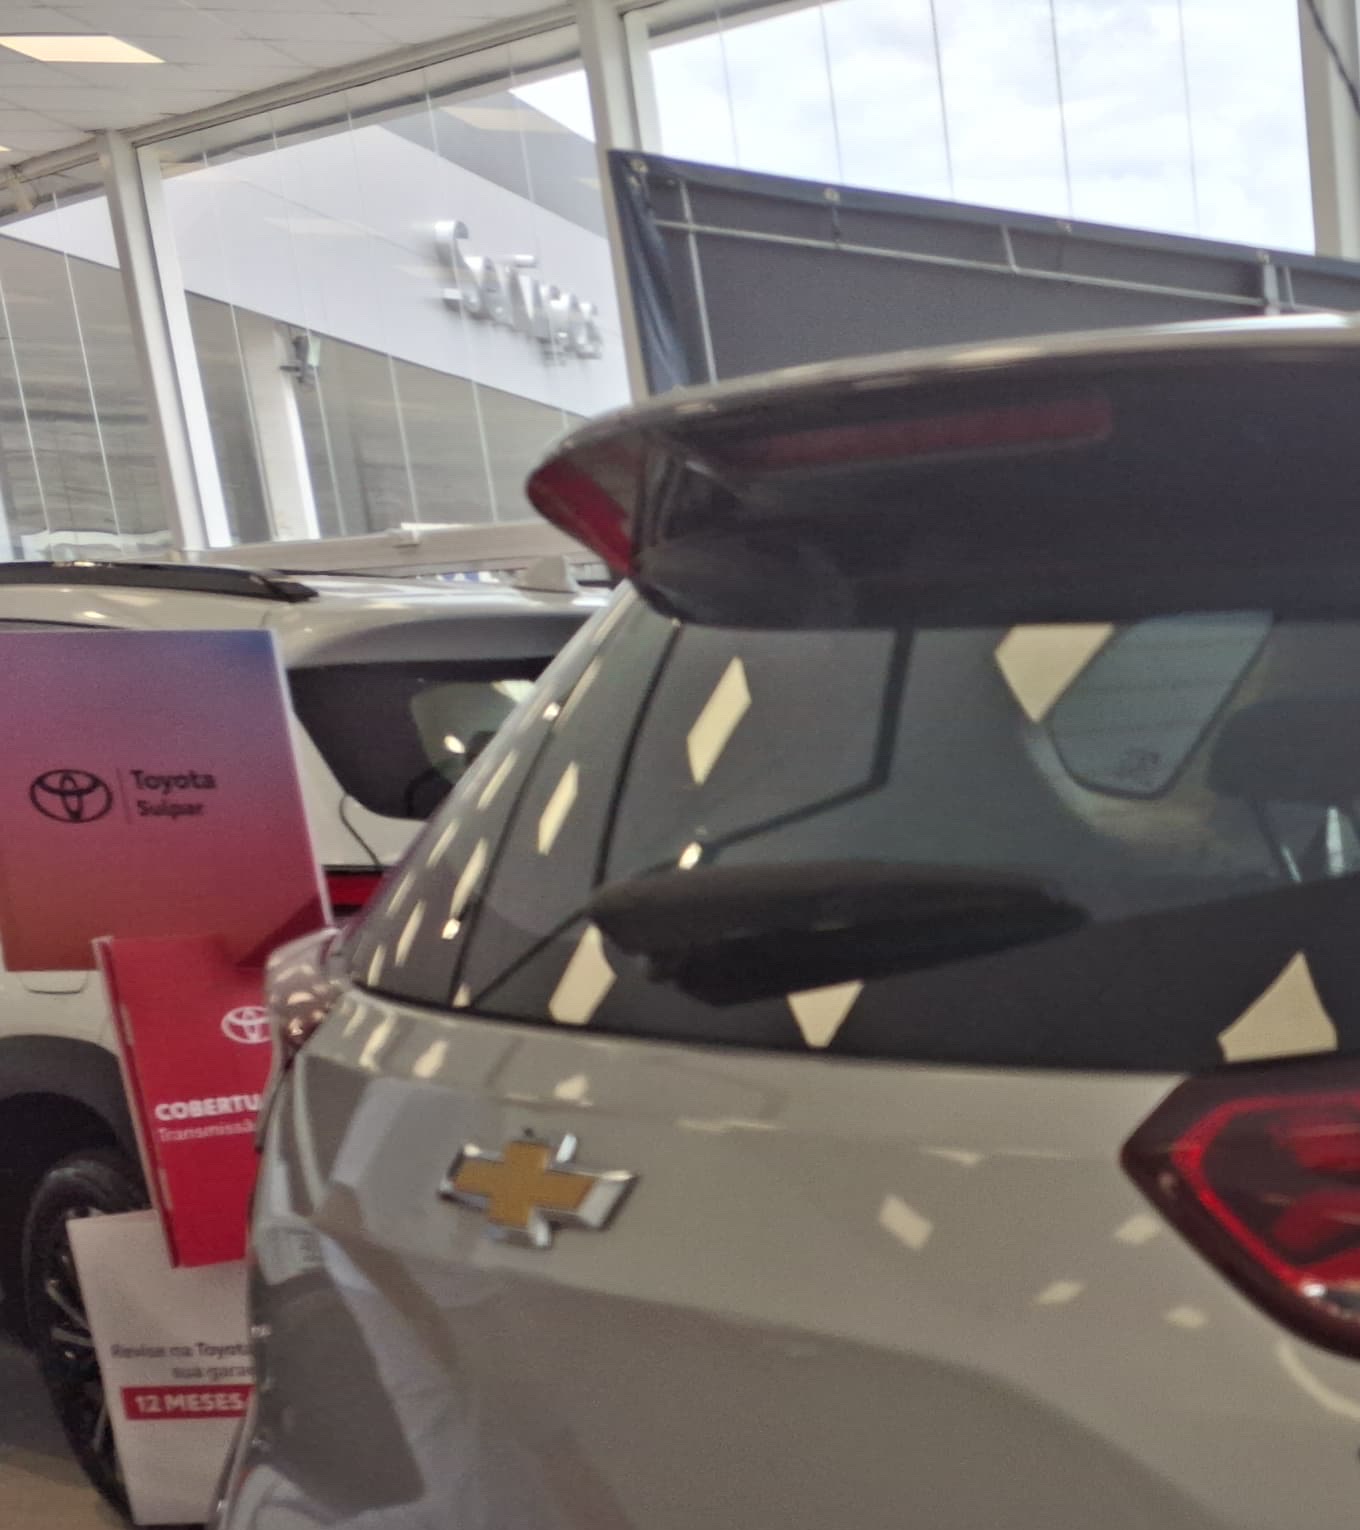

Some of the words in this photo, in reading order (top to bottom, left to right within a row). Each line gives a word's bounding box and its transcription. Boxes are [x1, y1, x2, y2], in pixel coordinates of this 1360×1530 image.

[130, 769, 217, 795] Toyota
[134, 1394, 162, 1413] 12
[164, 1392, 244, 1412] MESES
